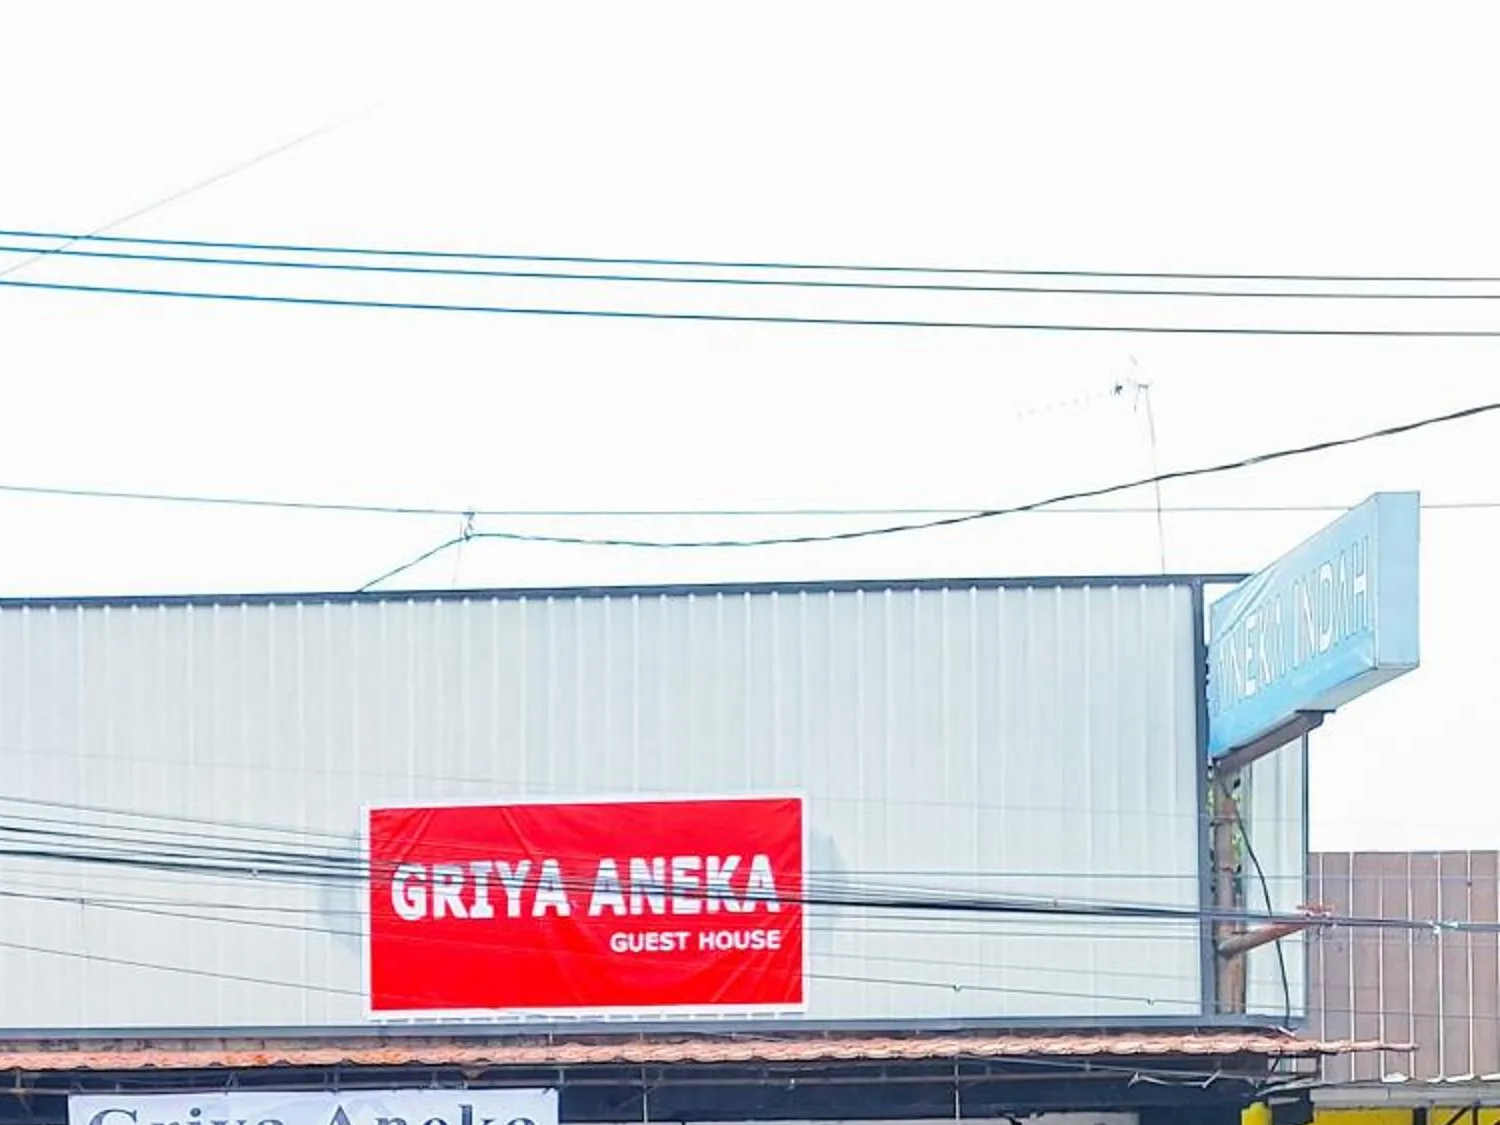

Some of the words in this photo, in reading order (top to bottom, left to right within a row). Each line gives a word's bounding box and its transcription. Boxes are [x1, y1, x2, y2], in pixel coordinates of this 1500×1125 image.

[390, 858, 571, 921] GRIYA
[588, 853, 781, 917] ANEKA
[610, 931, 691, 953] GUEST
[699, 929, 781, 951] HOUSE
